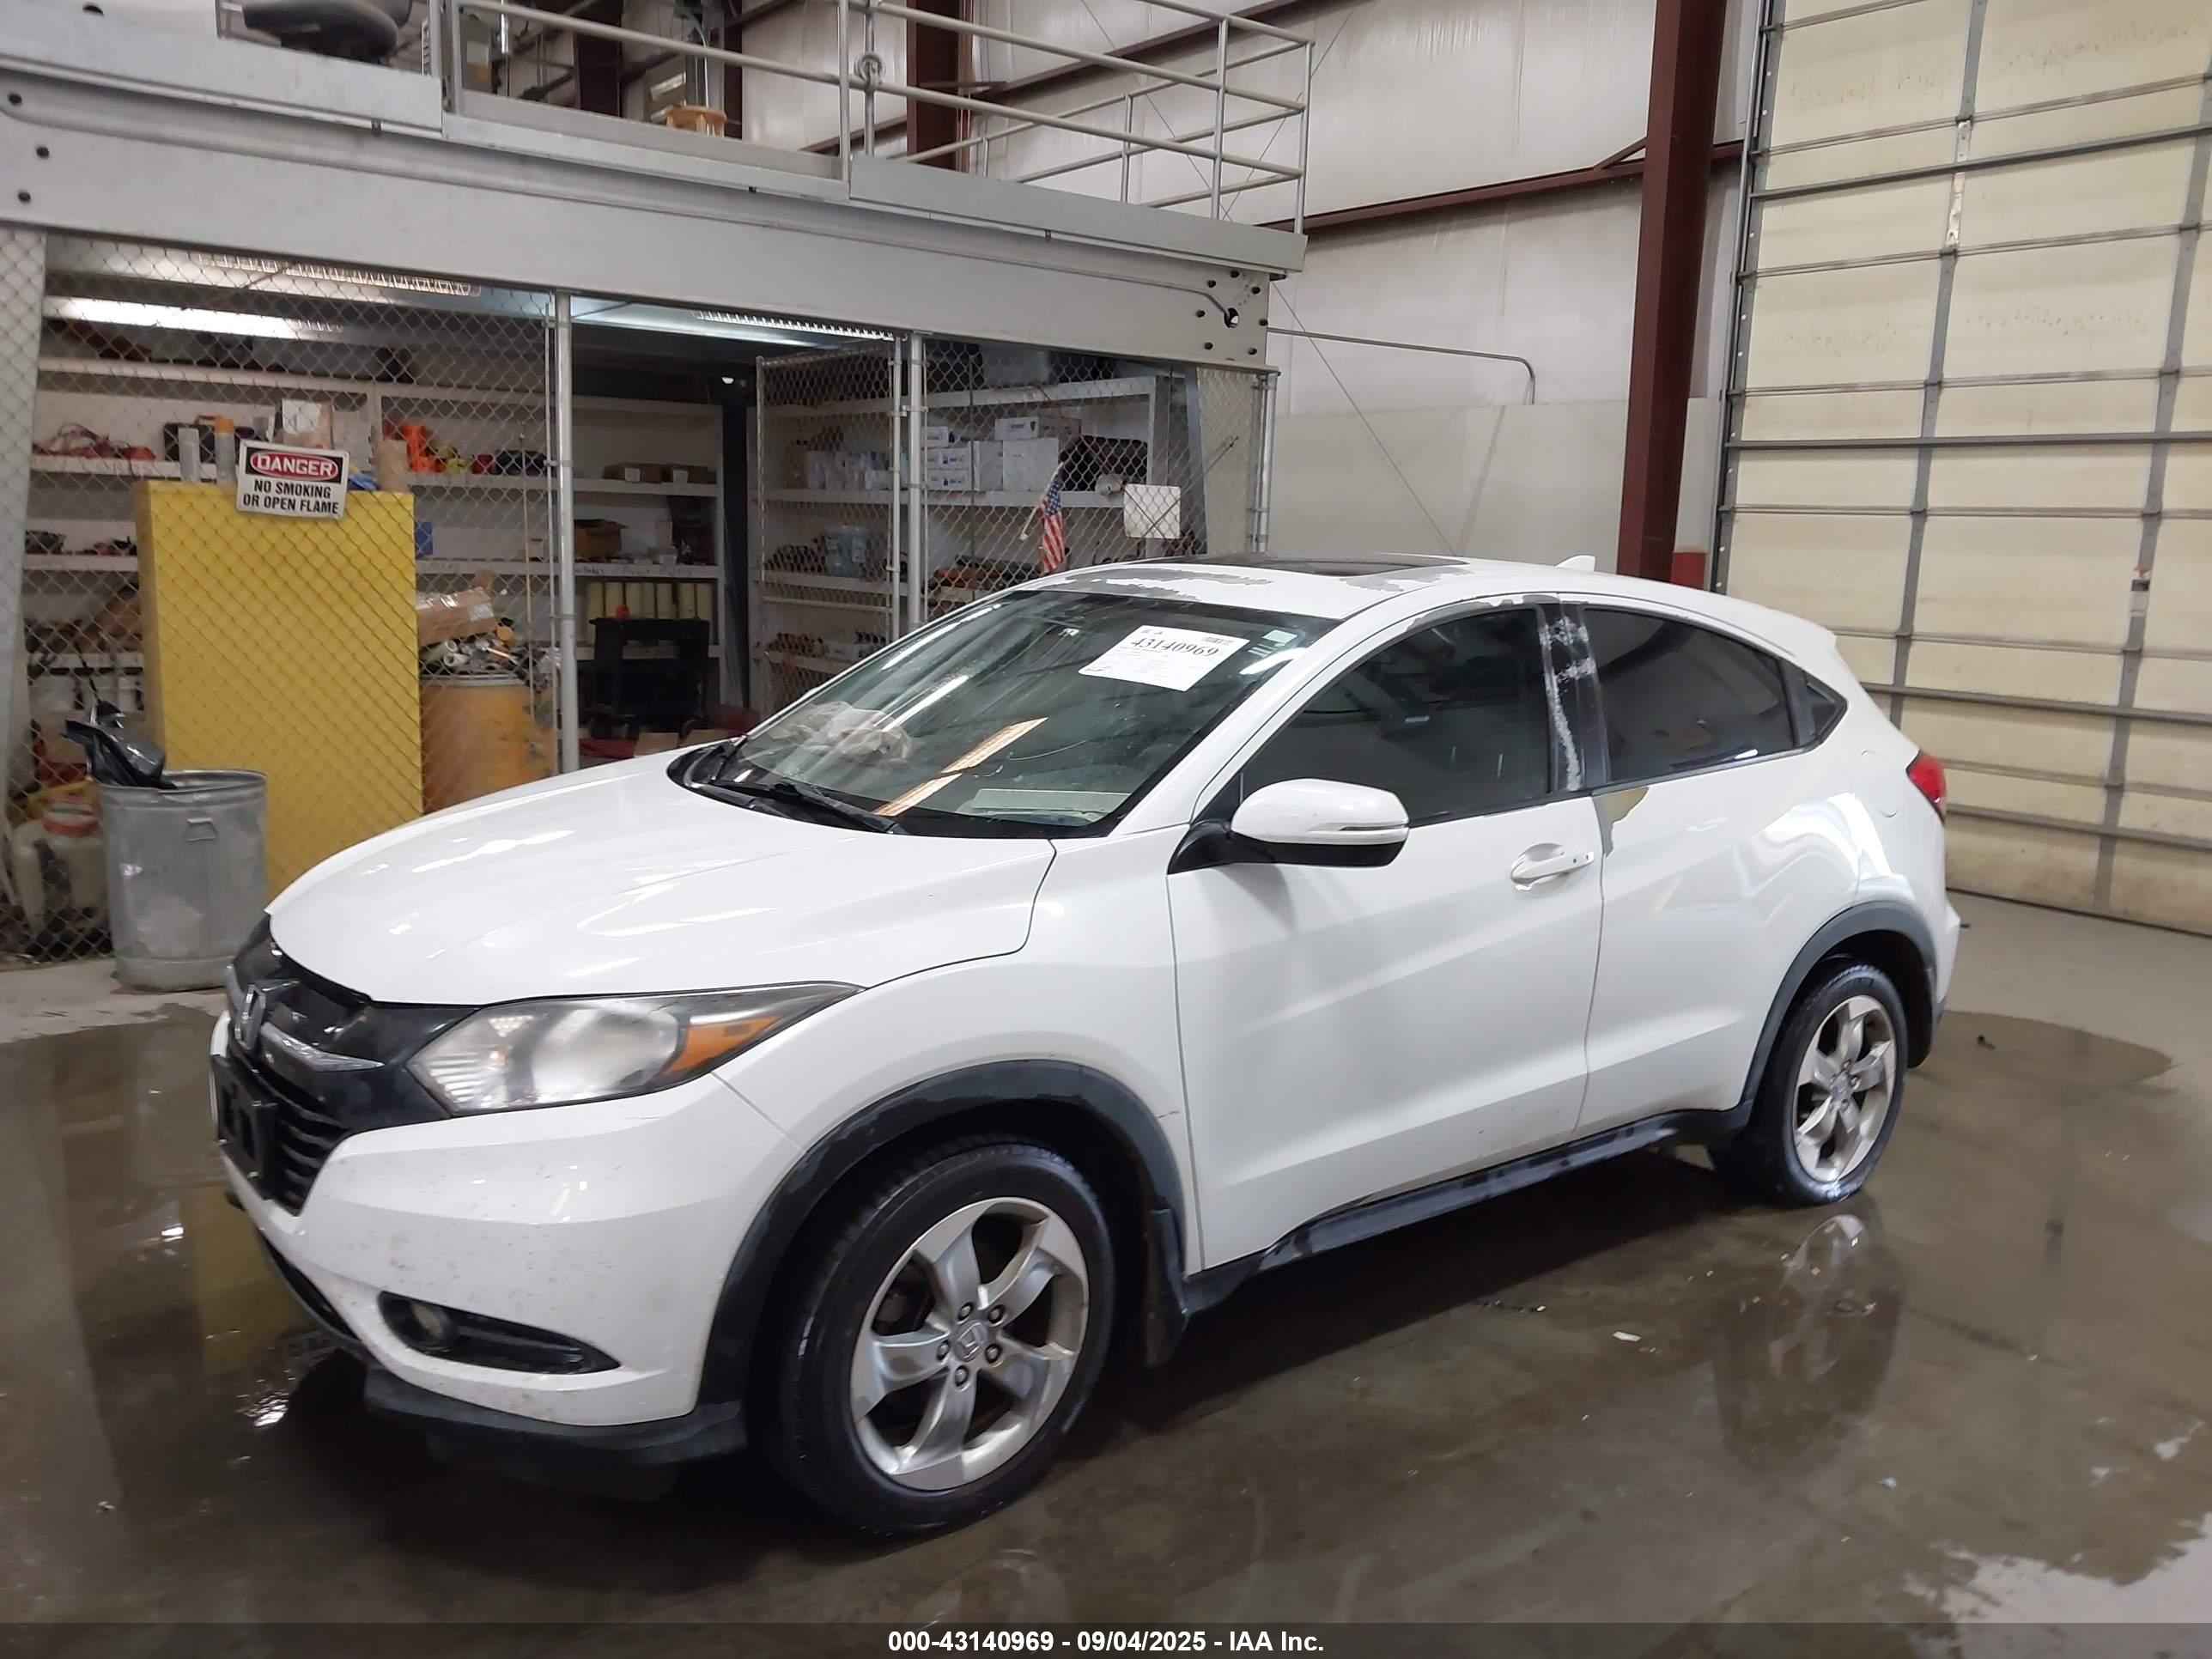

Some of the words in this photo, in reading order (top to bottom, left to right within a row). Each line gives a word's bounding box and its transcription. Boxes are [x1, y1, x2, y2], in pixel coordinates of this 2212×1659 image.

[258, 454, 332, 477] DANGER
[254, 479, 271, 493] NO
[275, 481, 331, 499] SMOKING
[243, 494, 259, 507] OR
[264, 495, 296, 511] OPEN
[300, 499, 339, 514] FLAME
[1131, 637, 1219, 657] 43140969
